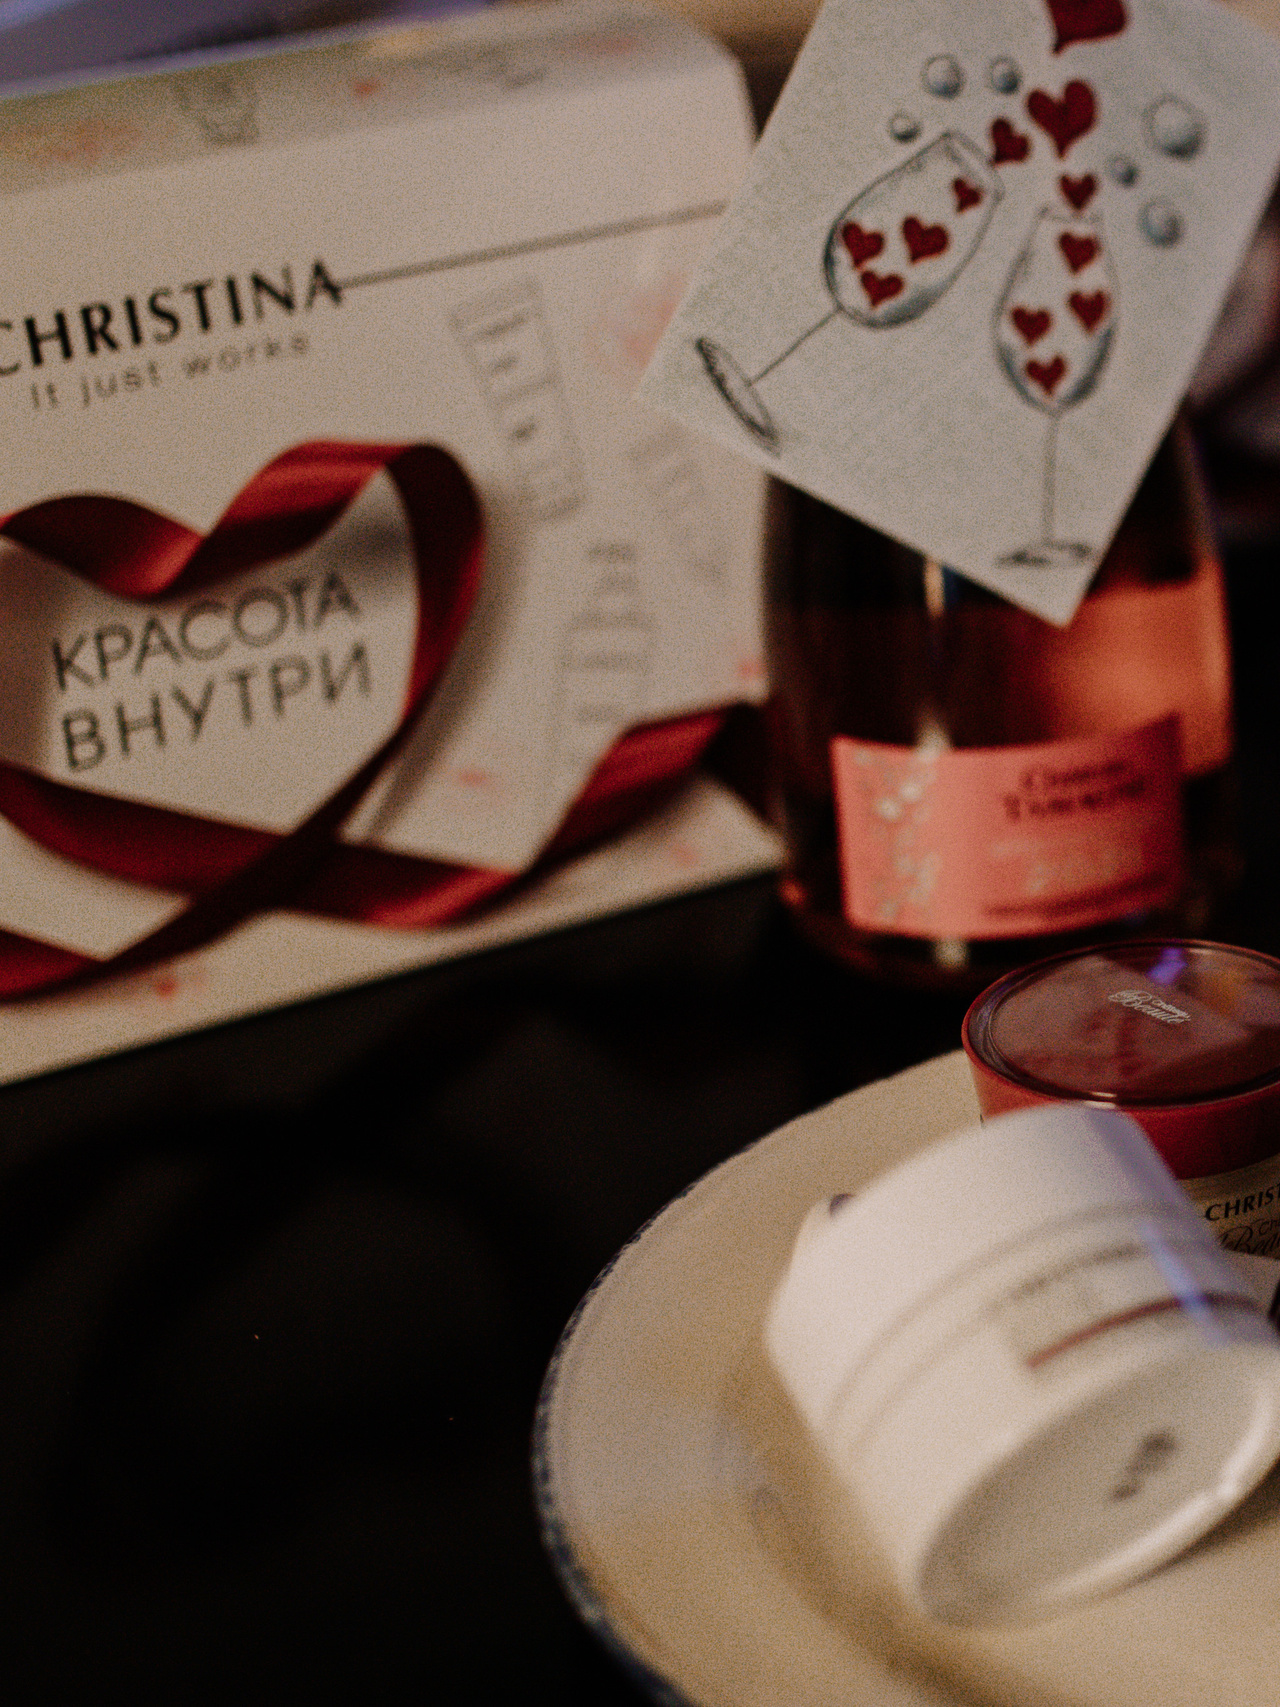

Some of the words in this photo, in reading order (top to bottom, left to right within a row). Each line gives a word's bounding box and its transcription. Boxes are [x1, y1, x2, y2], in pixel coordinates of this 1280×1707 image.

[29, 379, 60, 410] It
[79, 361, 163, 407] just
[180, 333, 310, 382] works
[49, 569, 361, 695] КРАСОТА
[62, 643, 373, 772] ВНУТРИ
